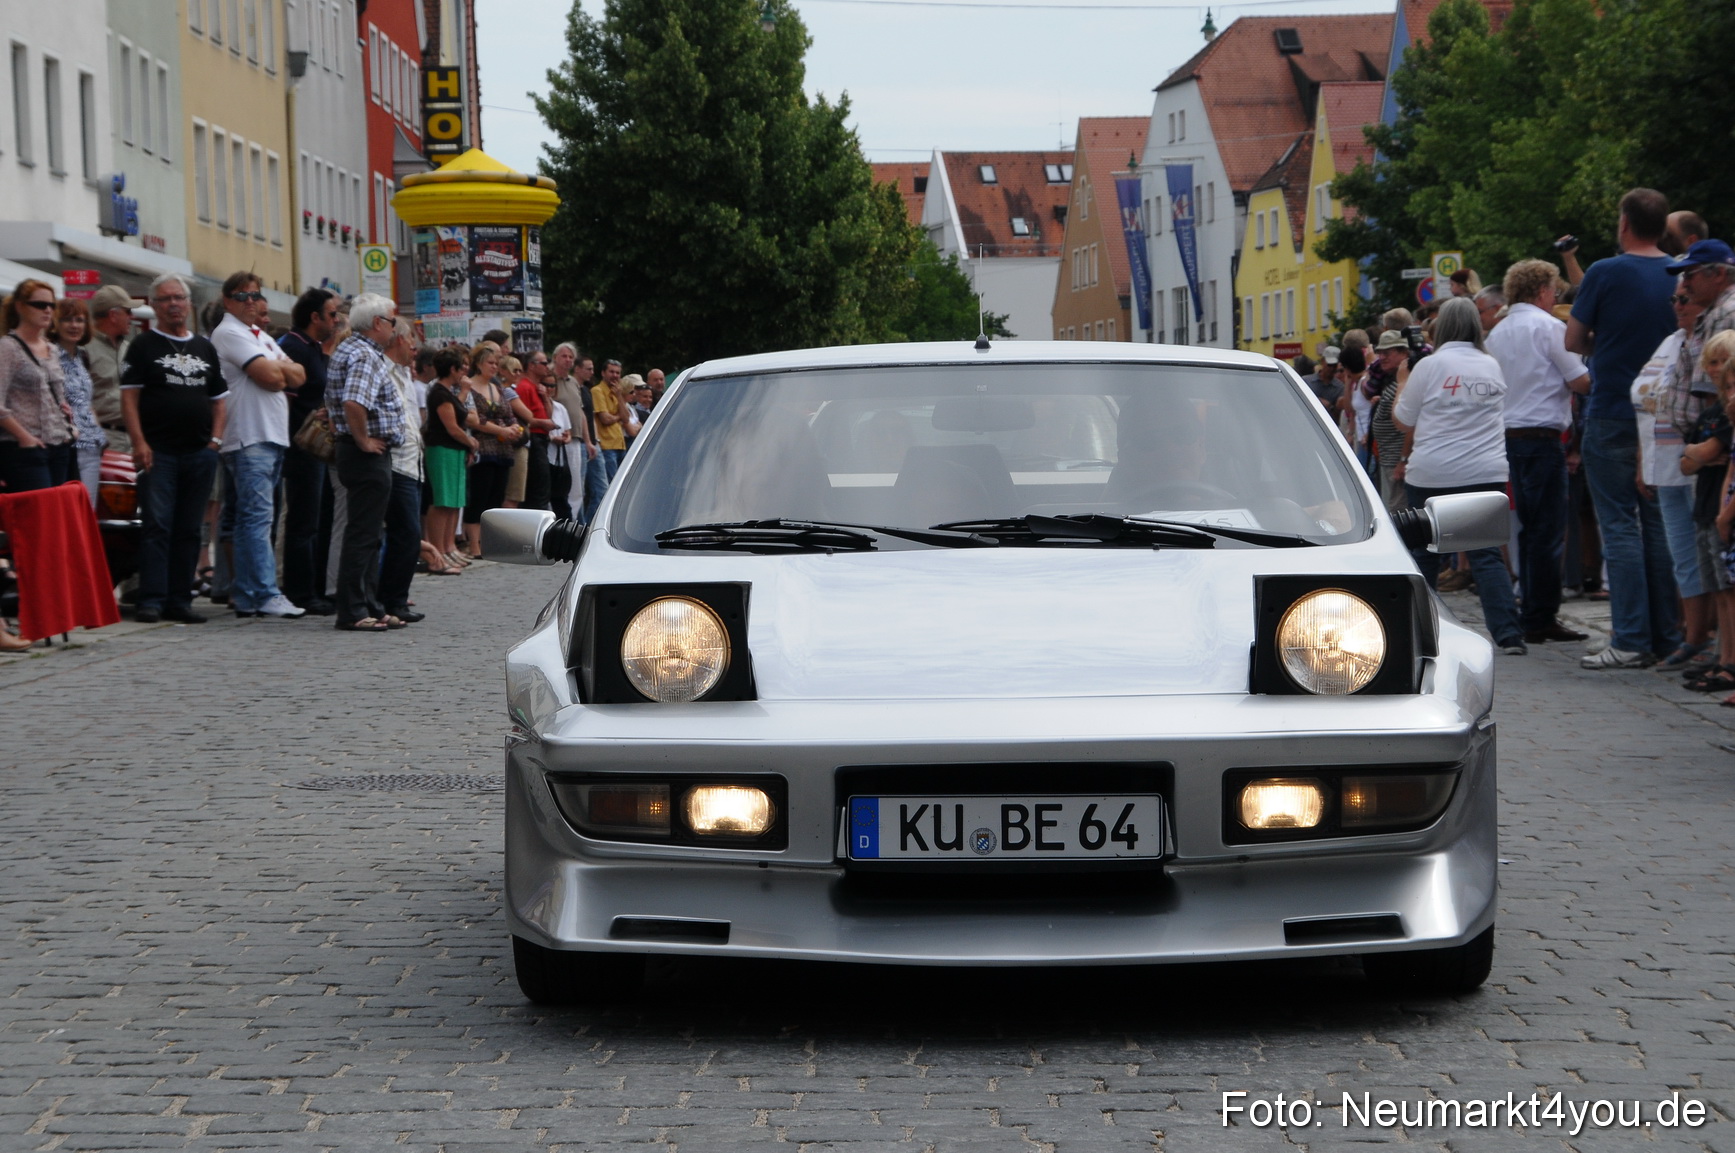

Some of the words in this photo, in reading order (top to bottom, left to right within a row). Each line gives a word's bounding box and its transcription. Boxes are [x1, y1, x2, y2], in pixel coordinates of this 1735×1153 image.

[859, 835, 870, 848] D
[899, 803, 964, 851] KU
[1001, 803, 1065, 851] BE
[1079, 803, 1139, 850] 64
